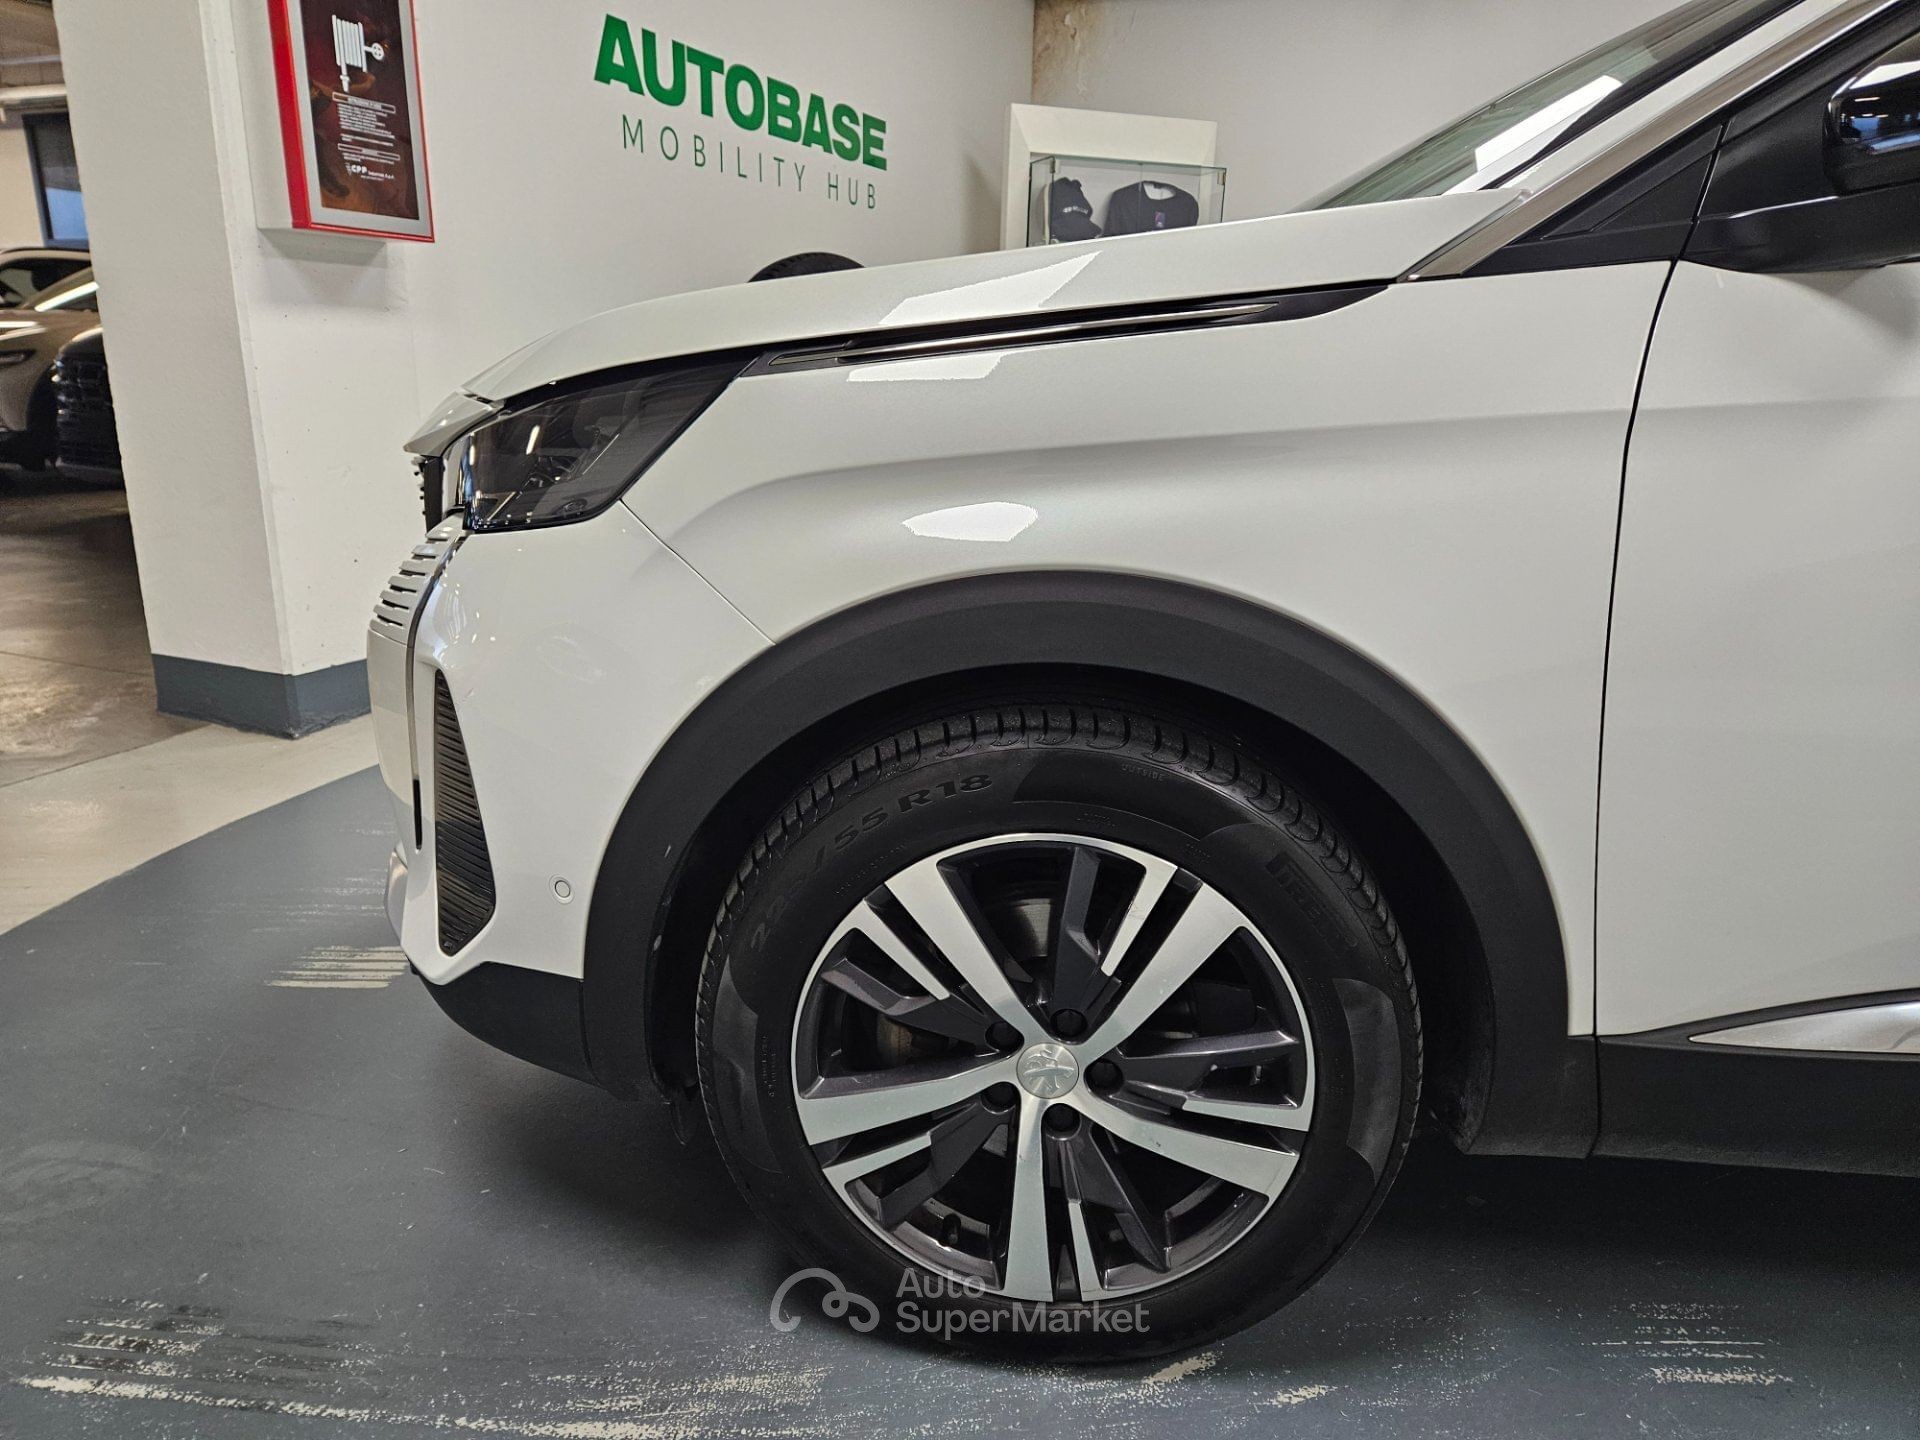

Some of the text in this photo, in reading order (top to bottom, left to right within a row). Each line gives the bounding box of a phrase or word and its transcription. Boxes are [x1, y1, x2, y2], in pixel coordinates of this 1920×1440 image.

[594, 13, 887, 171] AUTOBASE
[622, 114, 876, 209] MOBILITY HUB
[898, 773, 993, 813] R18
